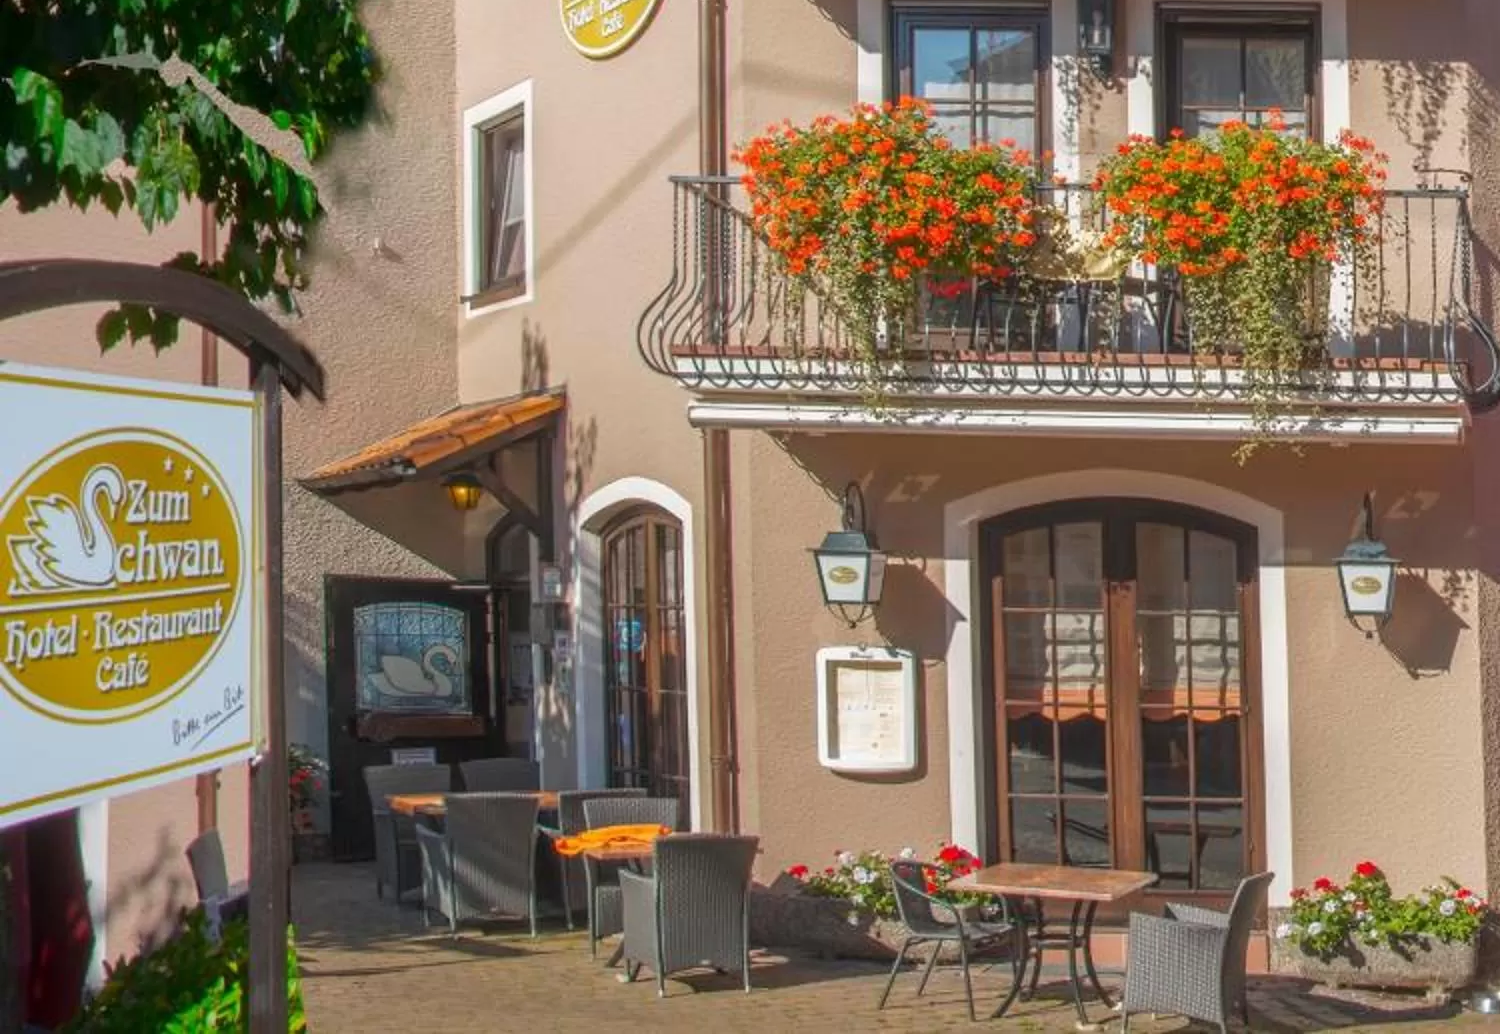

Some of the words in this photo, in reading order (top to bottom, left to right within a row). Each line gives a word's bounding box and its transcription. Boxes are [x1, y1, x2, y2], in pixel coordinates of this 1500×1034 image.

[126, 480, 191, 523] Zum
[4, 614, 79, 671] Hotel
[92, 598, 224, 652] Restaurant
[96, 653, 149, 691] Café
